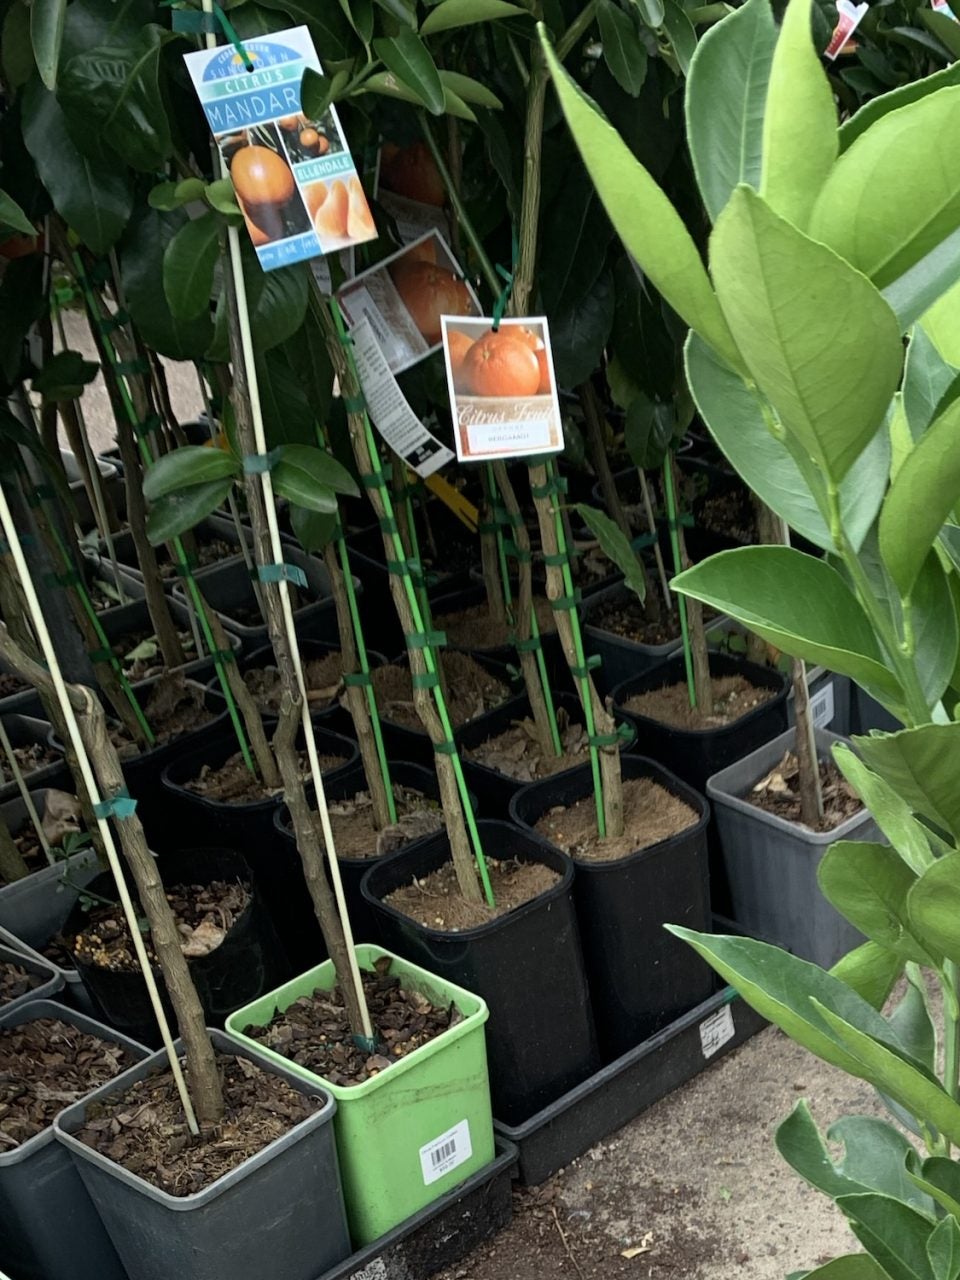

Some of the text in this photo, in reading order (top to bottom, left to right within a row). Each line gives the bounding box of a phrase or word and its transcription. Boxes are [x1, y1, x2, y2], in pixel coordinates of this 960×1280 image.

[225, 69, 284, 93] CITRUS
[206, 87, 300, 128] MANDAR
[296, 156, 351, 179] ELLENDALE
[457, 404, 506, 425] Citrus
